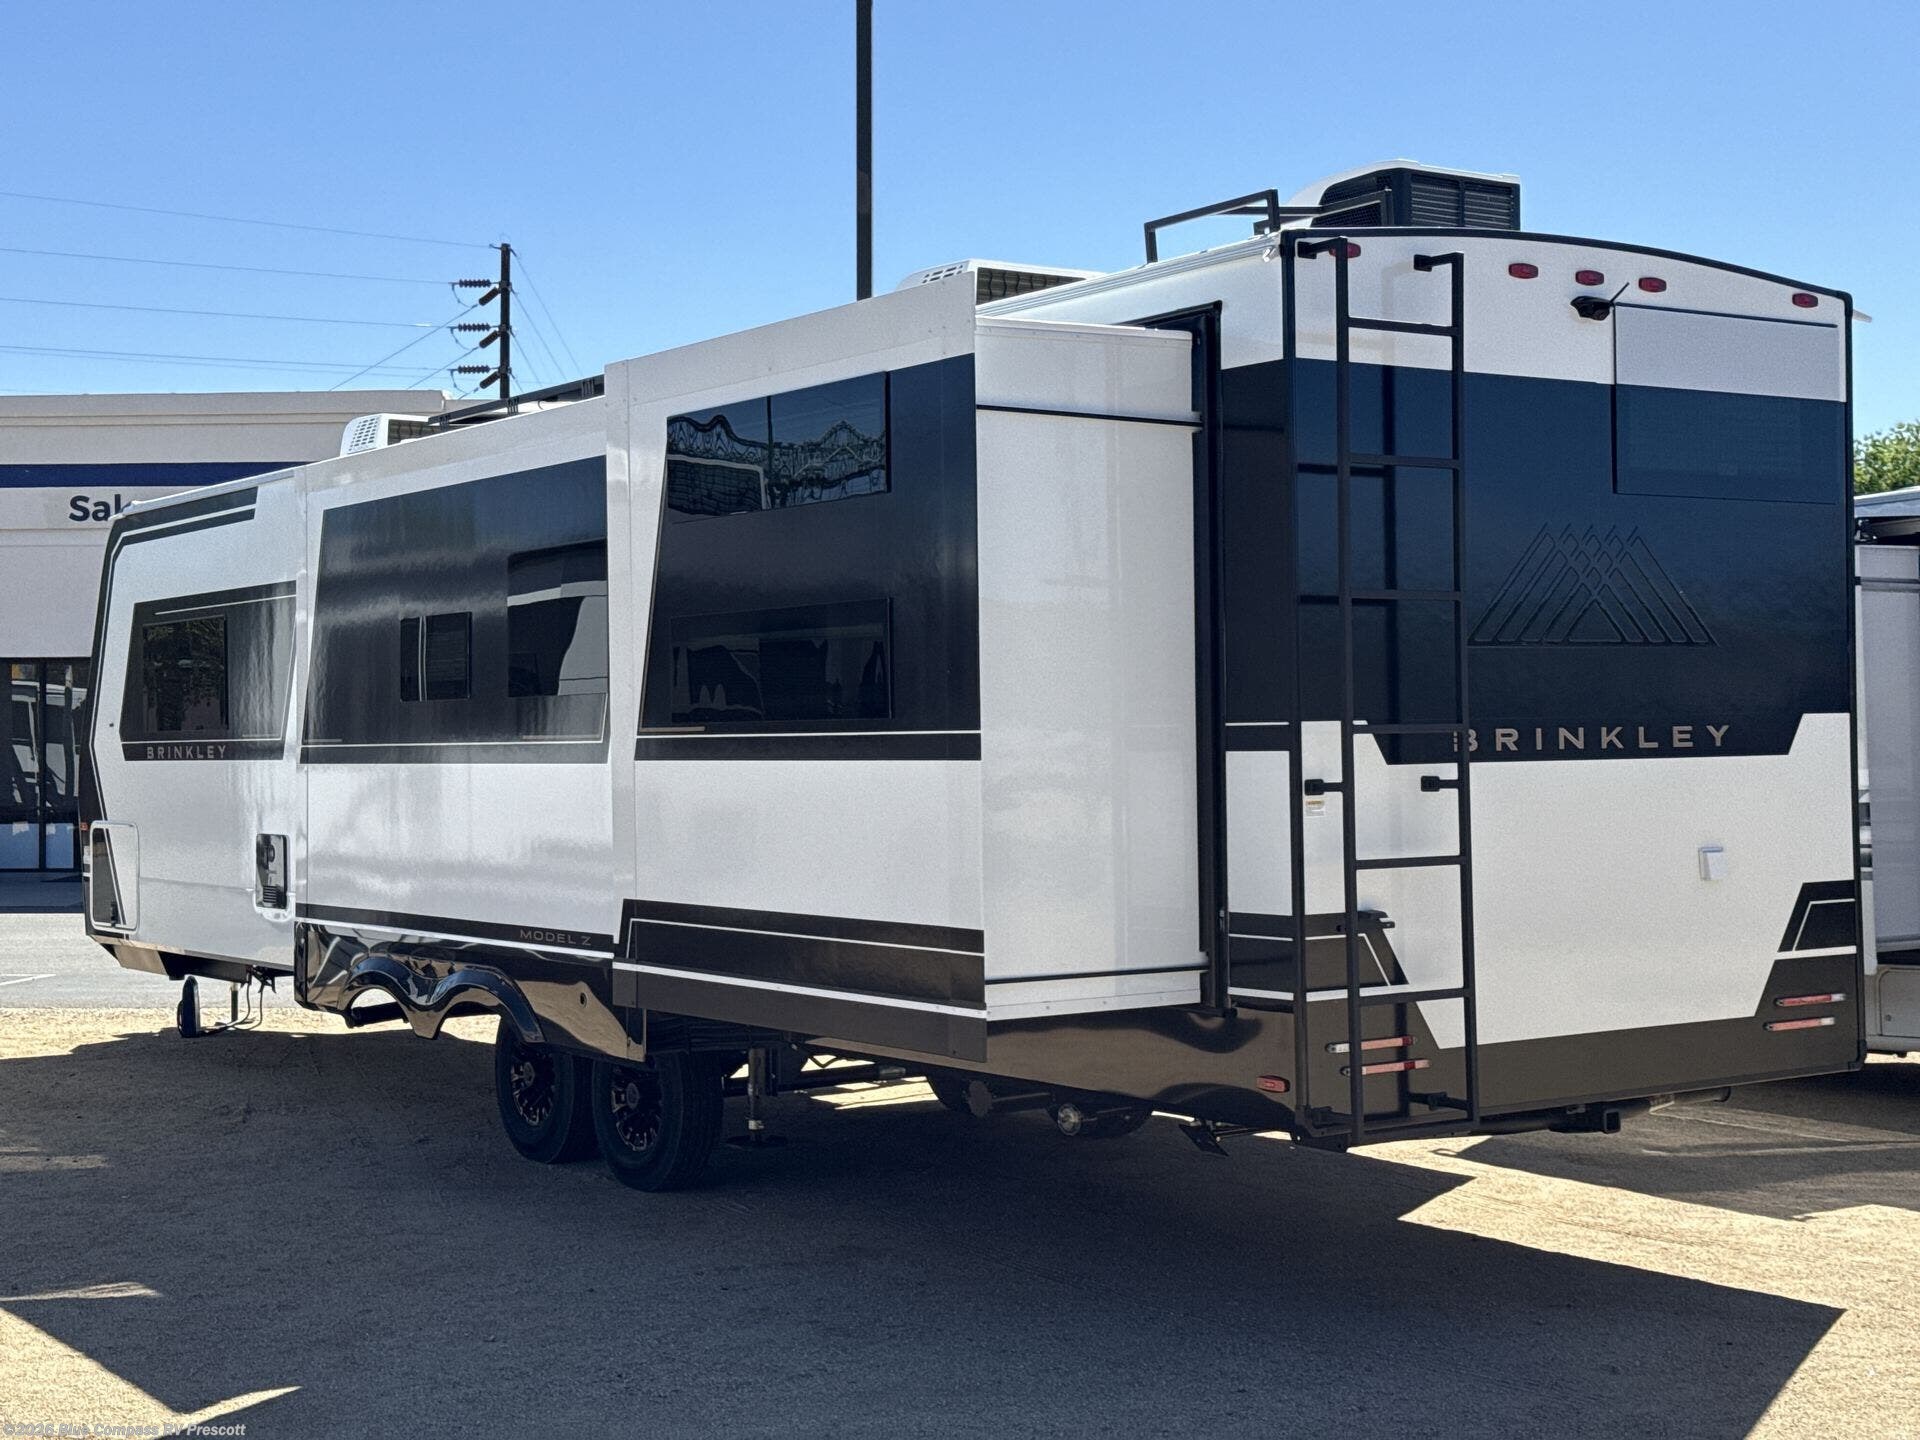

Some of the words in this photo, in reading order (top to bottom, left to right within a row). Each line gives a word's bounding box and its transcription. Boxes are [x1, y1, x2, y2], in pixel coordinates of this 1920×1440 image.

[69, 494, 132, 522] Sal
[146, 744, 226, 760] BRINKLEY
[520, 929, 577, 944] MODEL
[581, 935, 592, 946] Z
